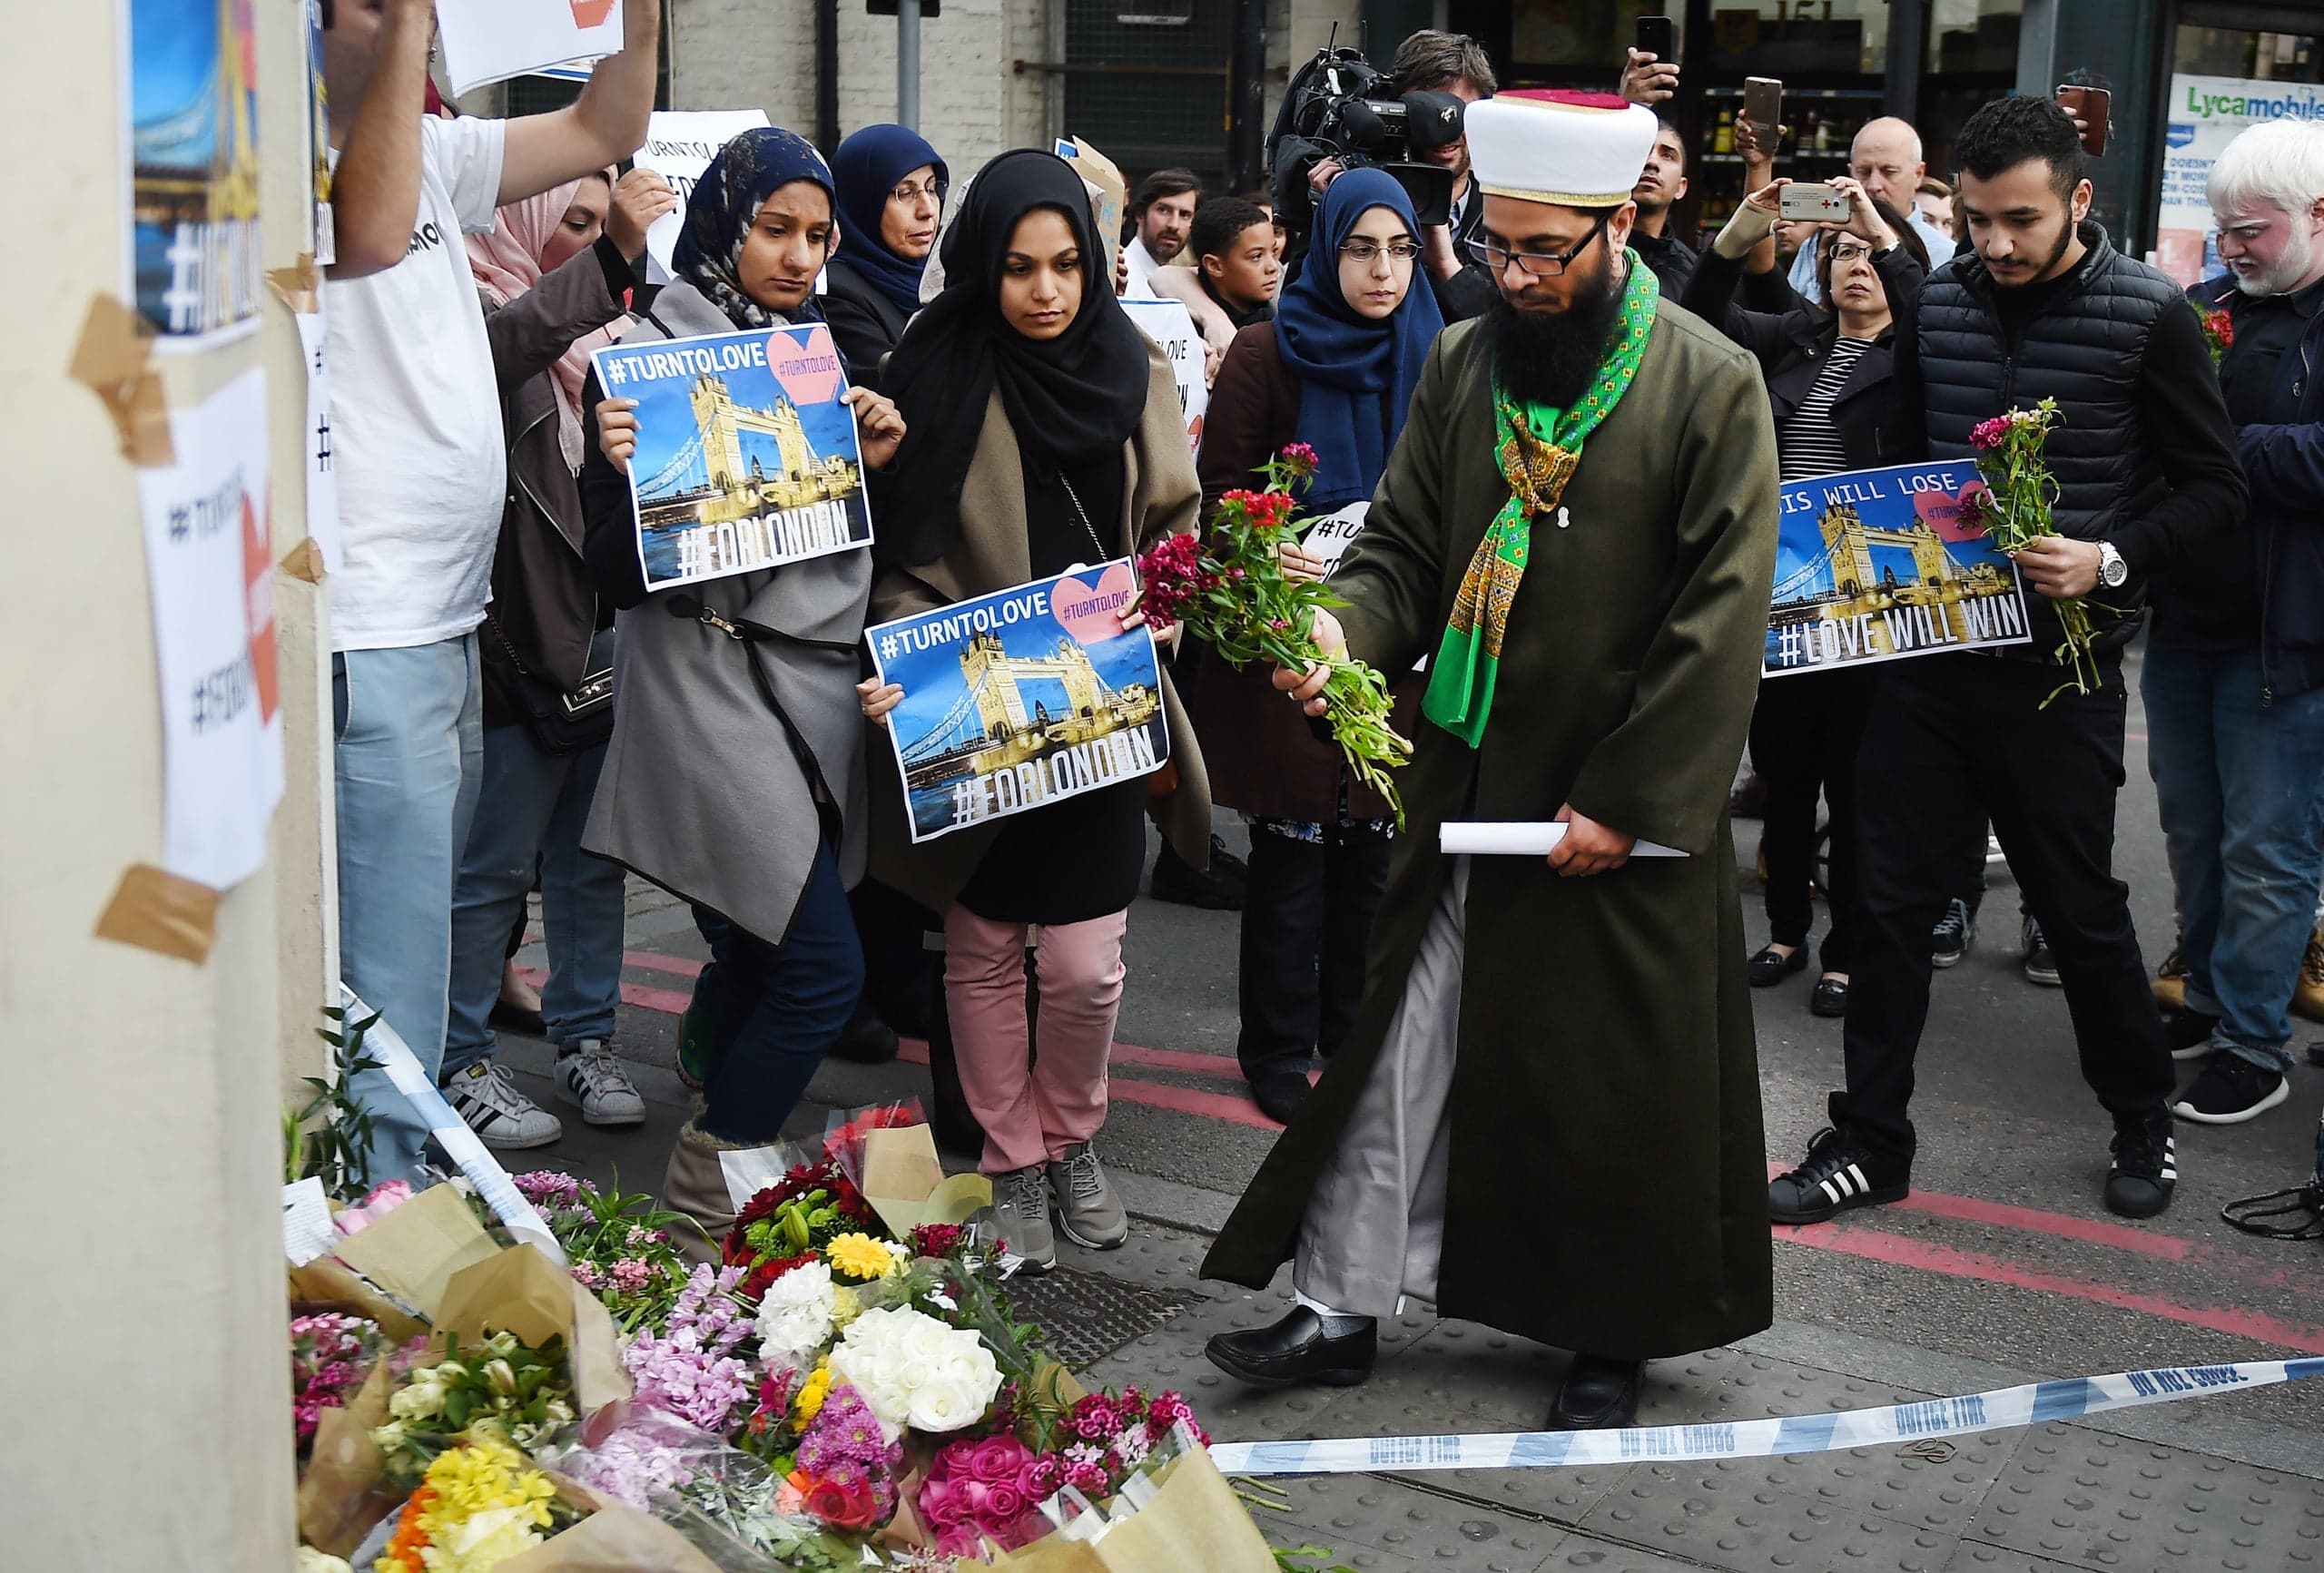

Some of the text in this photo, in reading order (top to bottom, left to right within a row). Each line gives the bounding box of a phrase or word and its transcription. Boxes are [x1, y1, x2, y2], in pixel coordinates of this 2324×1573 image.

[607, 341, 766, 385] #TURNTOLOVE
[779, 355, 836, 377] #TURNTOLOVE
[1823, 481, 1886, 506] WILL
[1897, 473, 1959, 496] LOSE
[676, 499, 852, 578] #FORLONDON
[881, 591, 1049, 660] #TURNTOLOVE
[1777, 594, 2024, 667] #LOVE WILL WIN
[952, 724, 1158, 825] #FORLONDON
